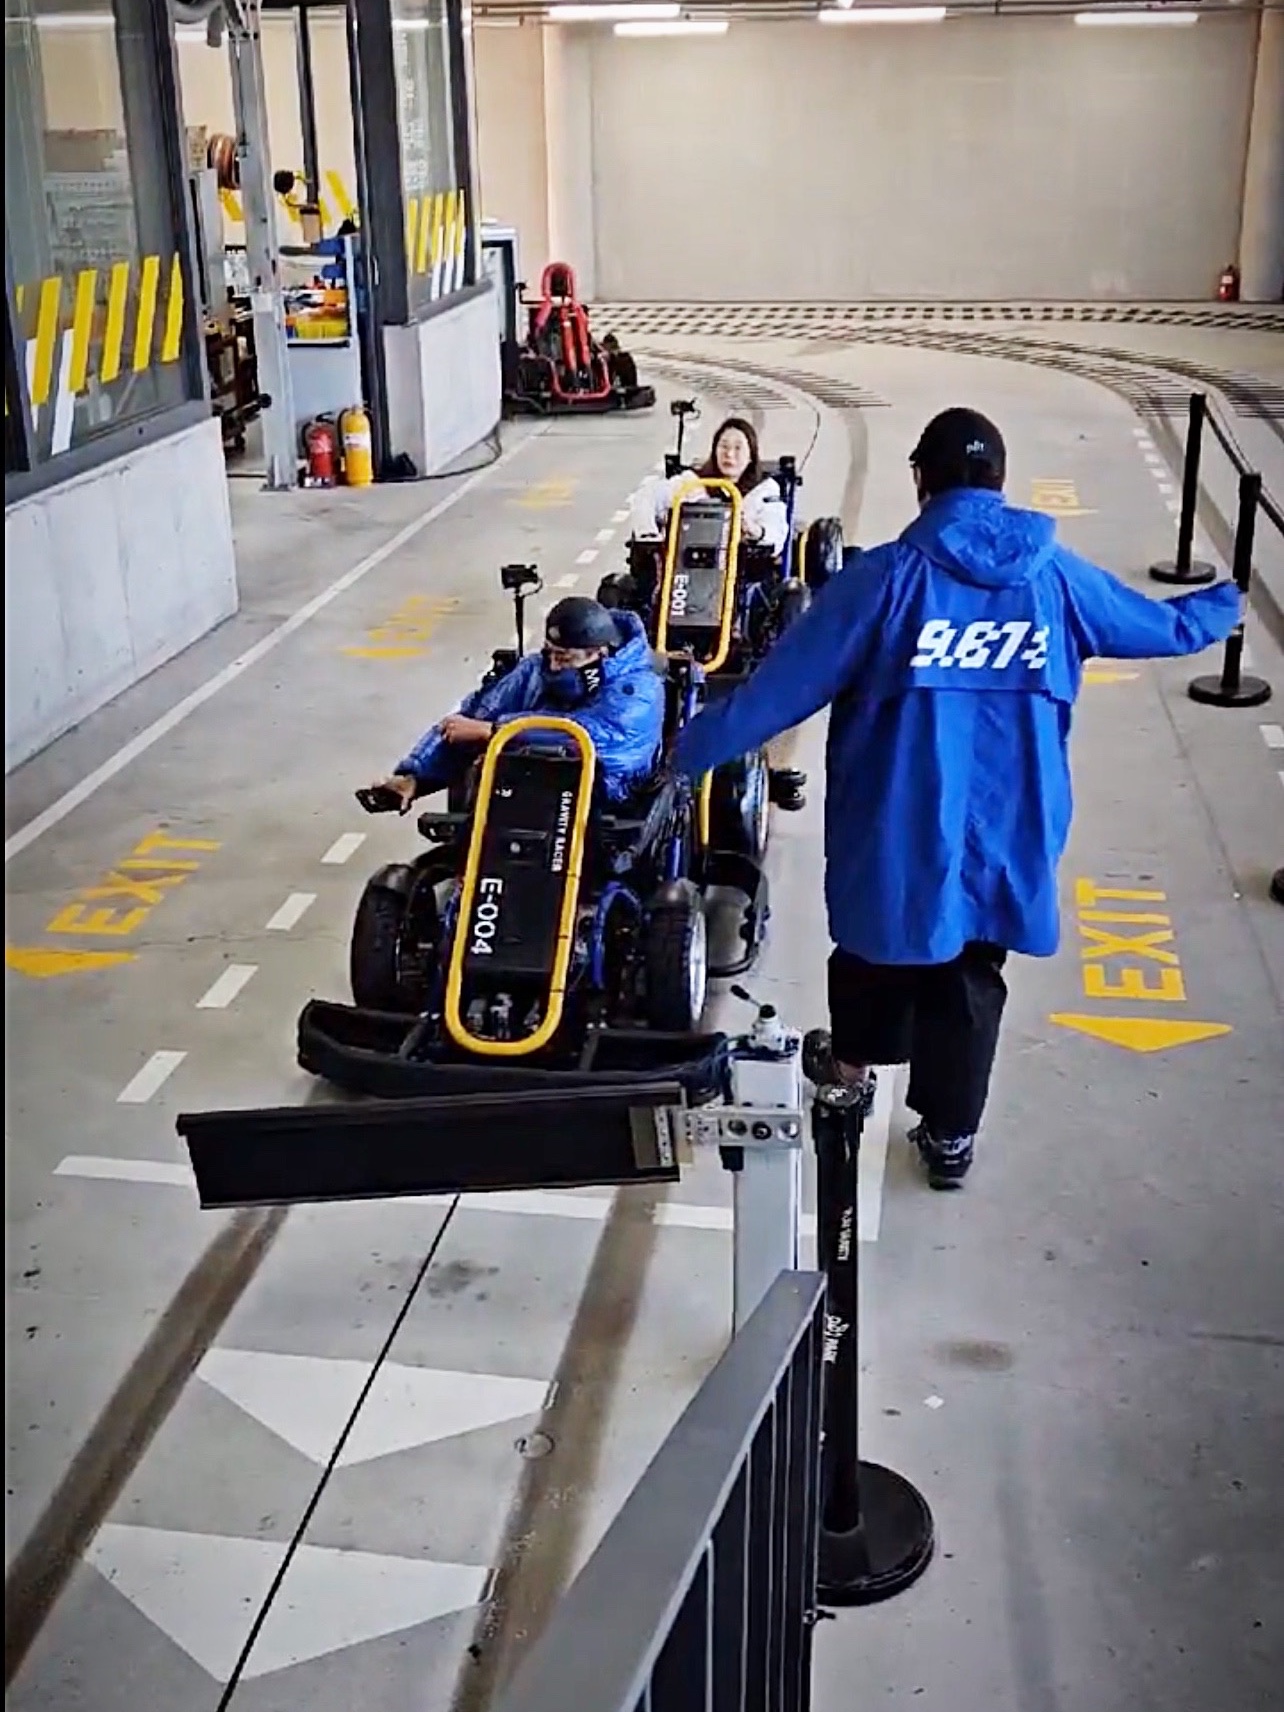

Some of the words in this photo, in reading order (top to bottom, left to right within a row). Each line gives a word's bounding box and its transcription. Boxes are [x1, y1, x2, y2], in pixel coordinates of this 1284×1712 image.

[671, 575, 690, 616] E-001
[557, 791, 573, 835] GRAVITY
[45, 830, 223, 935] EXIT
[551, 836, 566, 872] RACER
[471, 878, 503, 954] E-004
[1075, 877, 1187, 1001] EXIT
